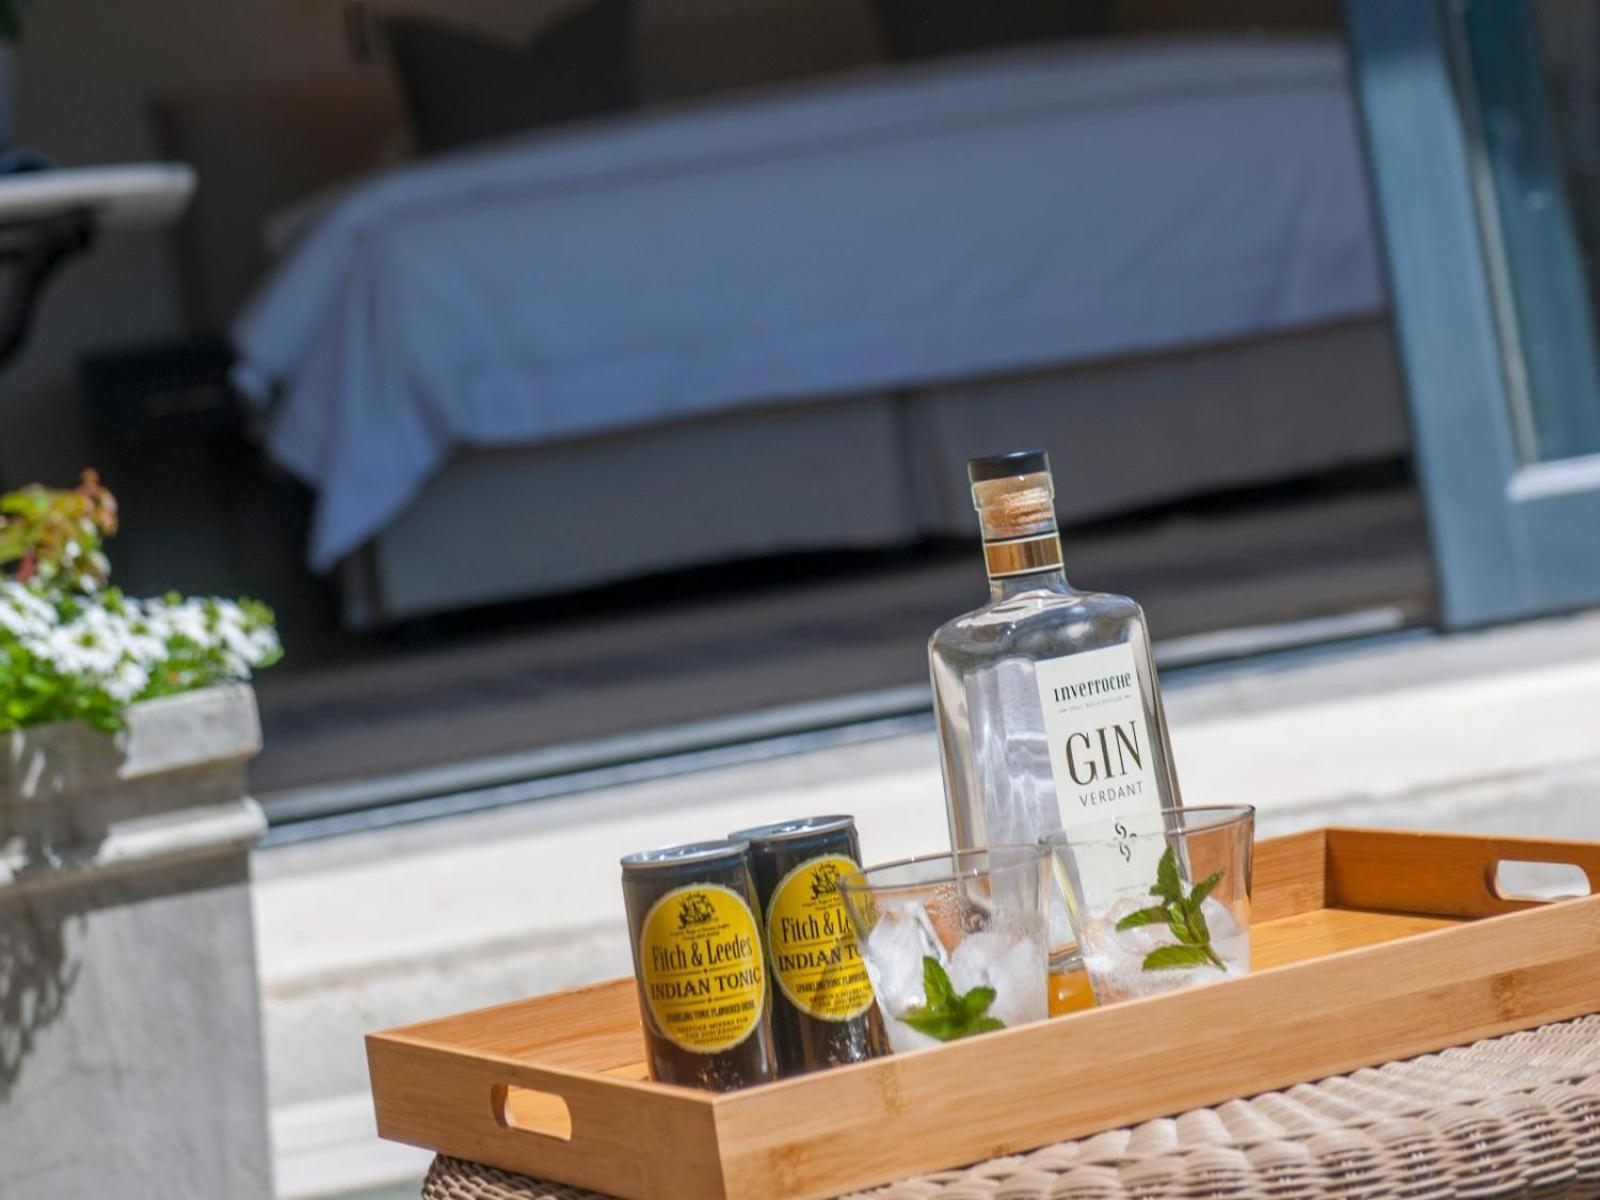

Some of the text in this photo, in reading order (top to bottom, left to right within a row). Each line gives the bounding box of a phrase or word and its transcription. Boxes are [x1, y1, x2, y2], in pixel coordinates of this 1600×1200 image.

[1065, 720, 1143, 786] GIN
[1079, 781, 1143, 807] VERDANT
[781, 914, 820, 943] Fitch
[823, 911, 834, 936] &
[652, 934, 753, 972] Fitch & Leedes
[778, 946, 842, 973] INDIAN
[651, 967, 762, 1000] INDIAN TONIC
